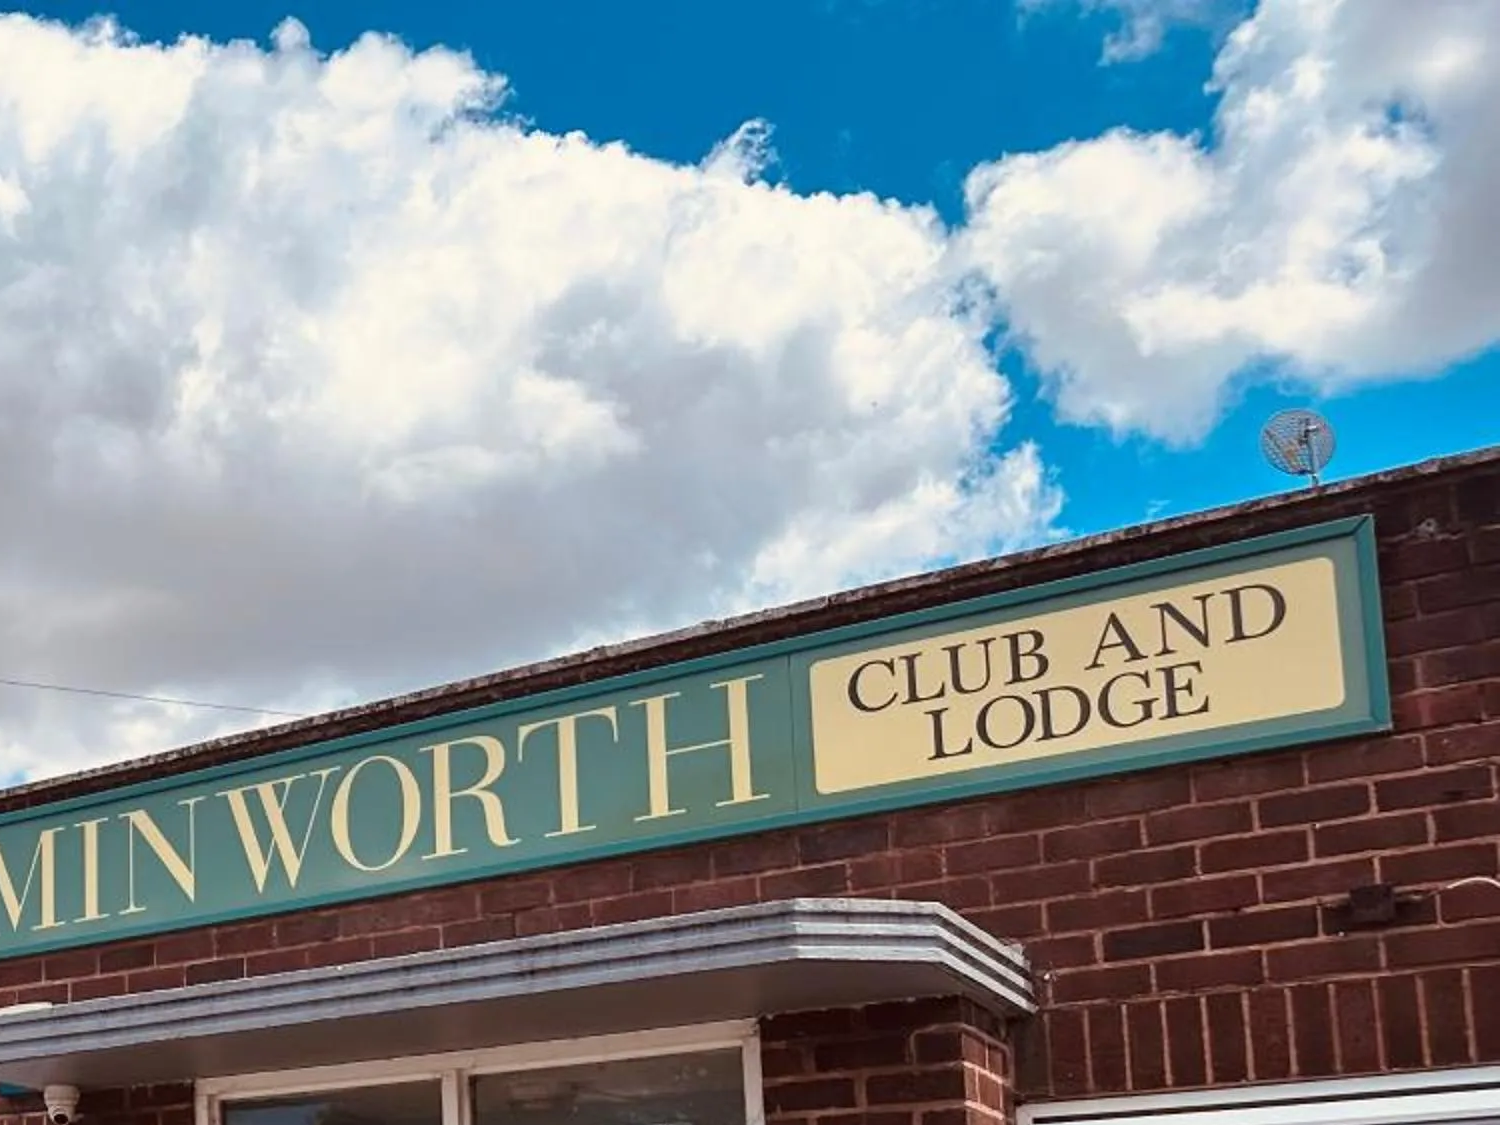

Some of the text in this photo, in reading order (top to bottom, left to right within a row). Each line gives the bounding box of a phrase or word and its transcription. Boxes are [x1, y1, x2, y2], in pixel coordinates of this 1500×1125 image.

[848, 583, 1287, 713] CLUB AND
[925, 661, 1210, 761] LODGE
